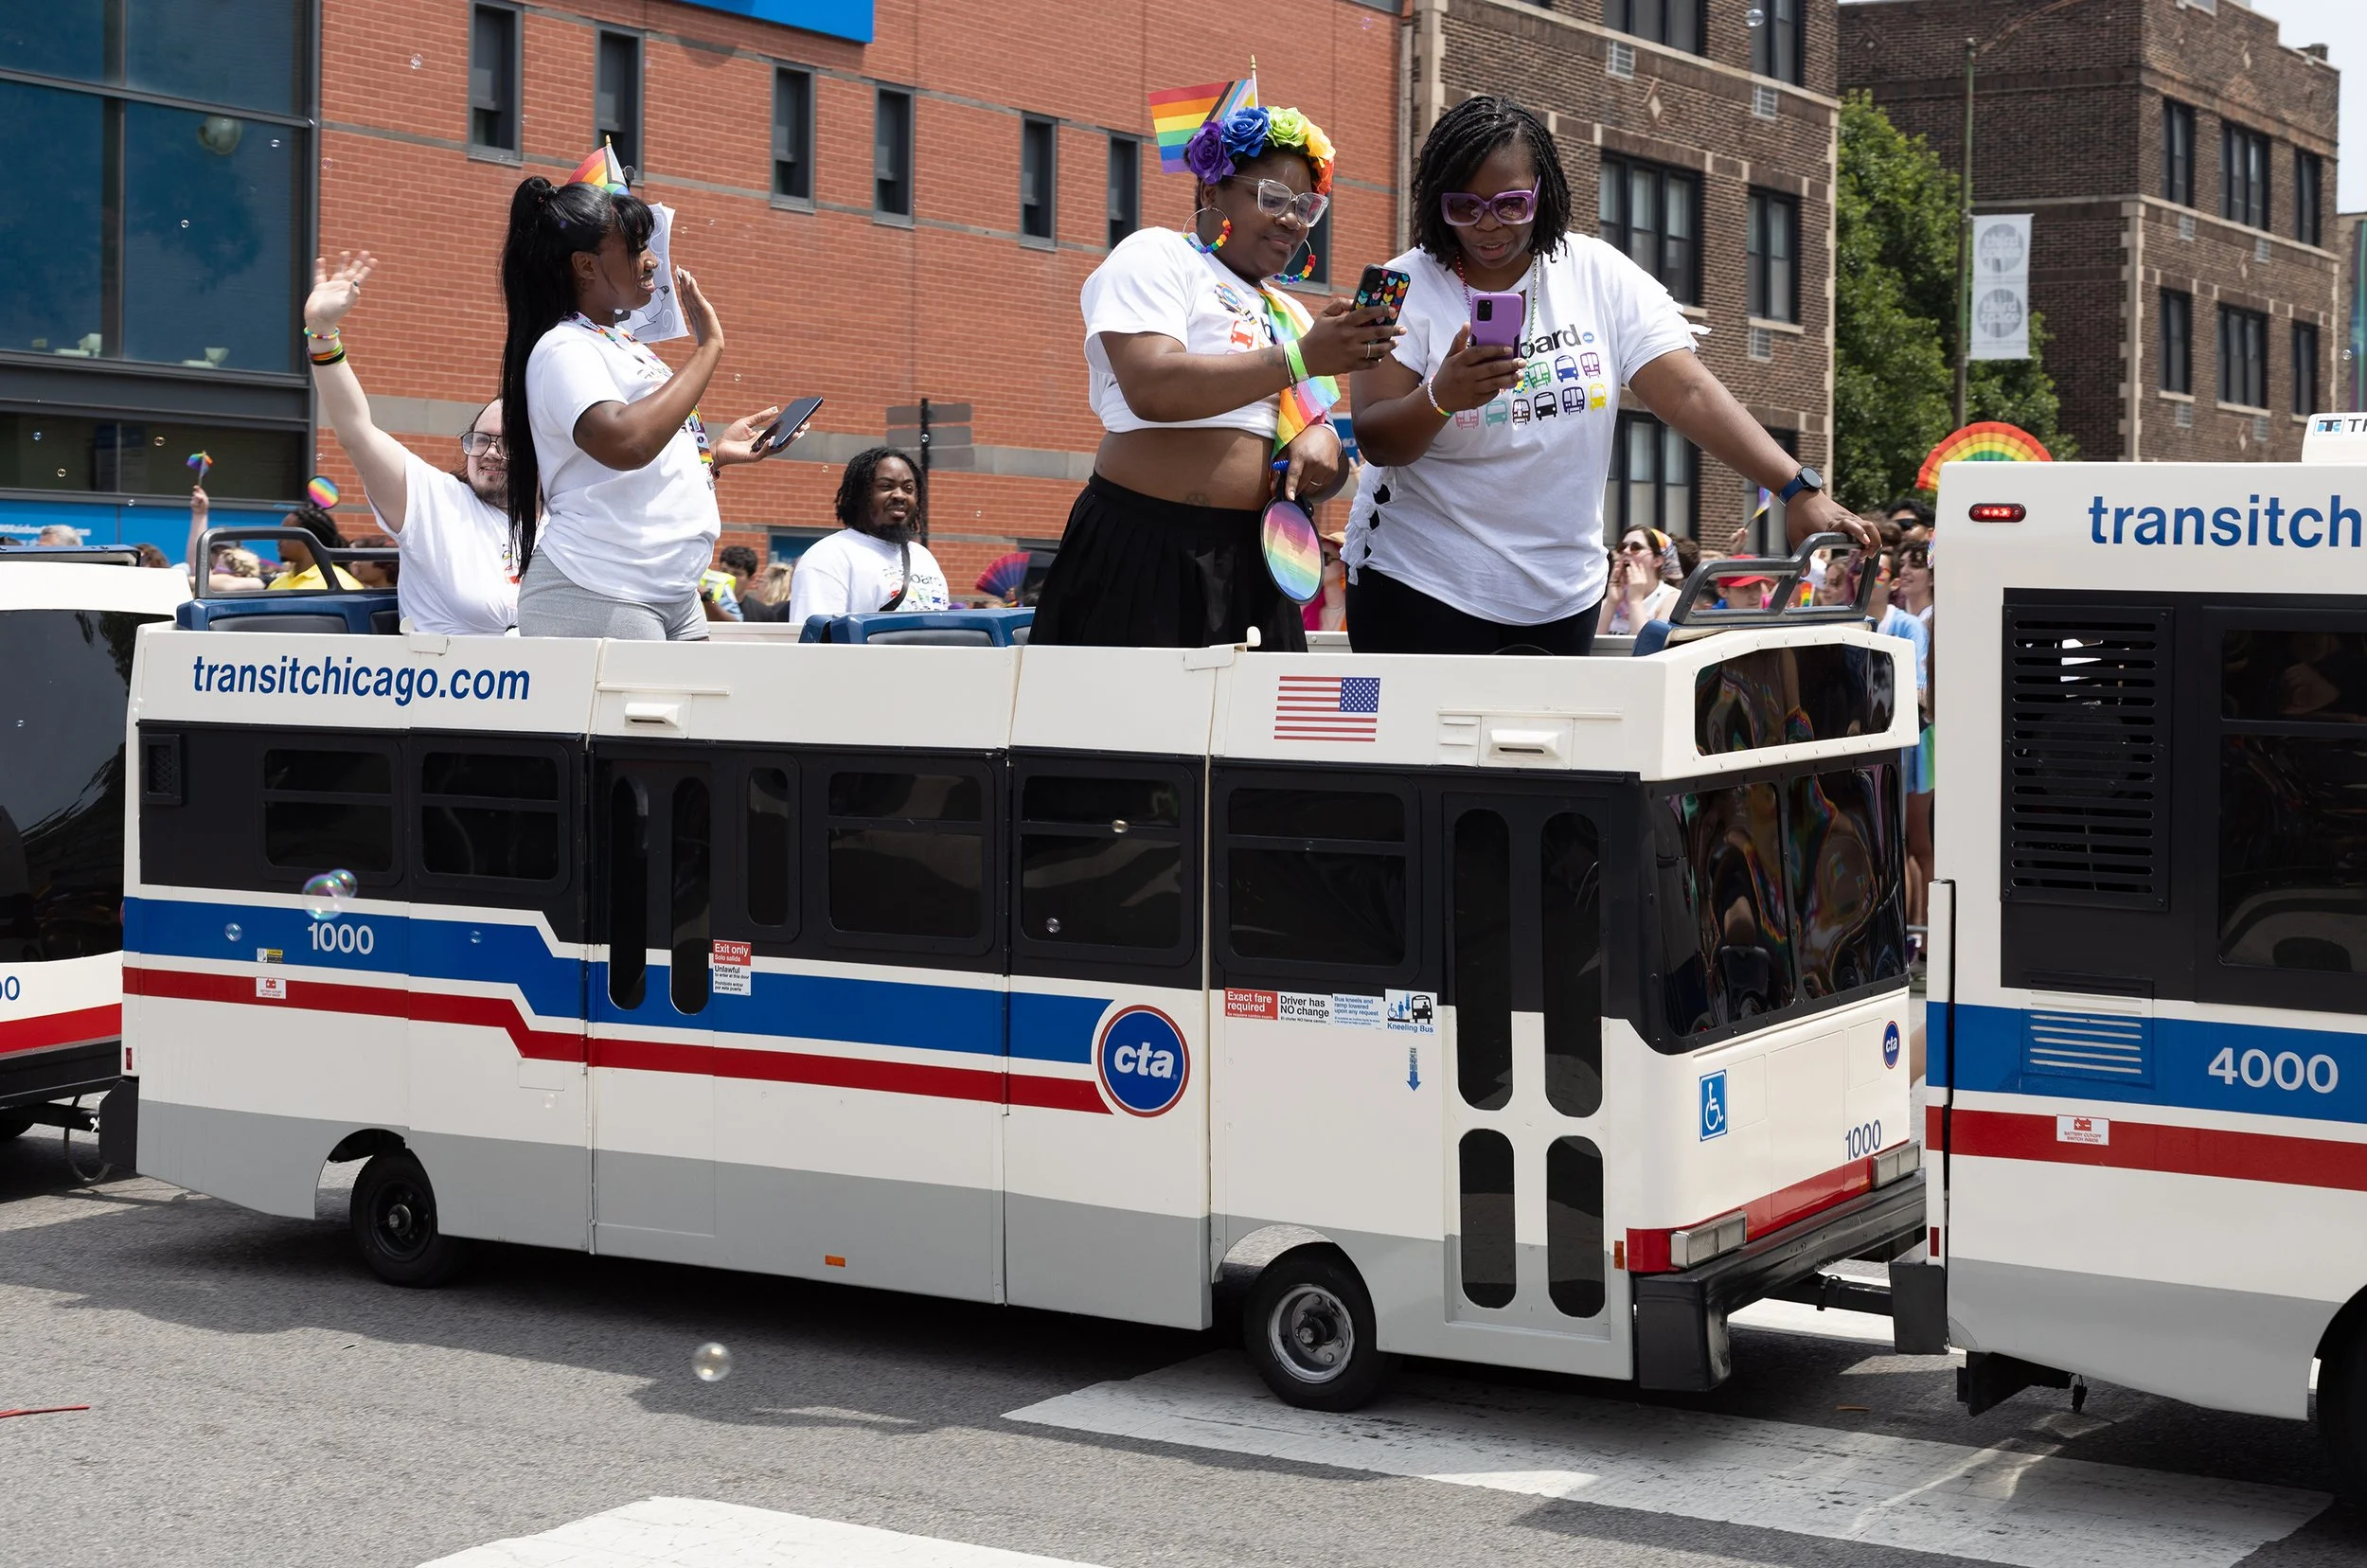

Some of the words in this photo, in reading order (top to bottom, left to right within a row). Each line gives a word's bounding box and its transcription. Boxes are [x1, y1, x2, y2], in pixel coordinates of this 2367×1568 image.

[1520, 324, 1581, 359] oard
[2088, 494, 2362, 548] transitch
[193, 655, 530, 706] transitchicago.com
[308, 922, 374, 954] 1000
[715, 943, 730, 953] Exit
[731, 945, 749, 957] only
[714, 965, 740, 974] Unlawful
[0, 975, 20, 1001] 0
[1227, 990, 1252, 1002] Exact
[1254, 992, 1272, 1004] fare
[1227, 1002, 1266, 1013] required
[1280, 995, 1307, 1006] Driver
[1308, 997, 1326, 1007] has
[1280, 1006, 1295, 1014] NO
[1296, 1007, 1330, 1019] change
[1387, 1023, 1418, 1033] Kneeling
[1419, 1025, 1433, 1033] Bus
[1885, 1036, 1898, 1053] cta
[1114, 1042, 1174, 1078] cta
[2208, 1047, 2339, 1094] 4000
[1845, 1119, 1881, 1161] 1000
